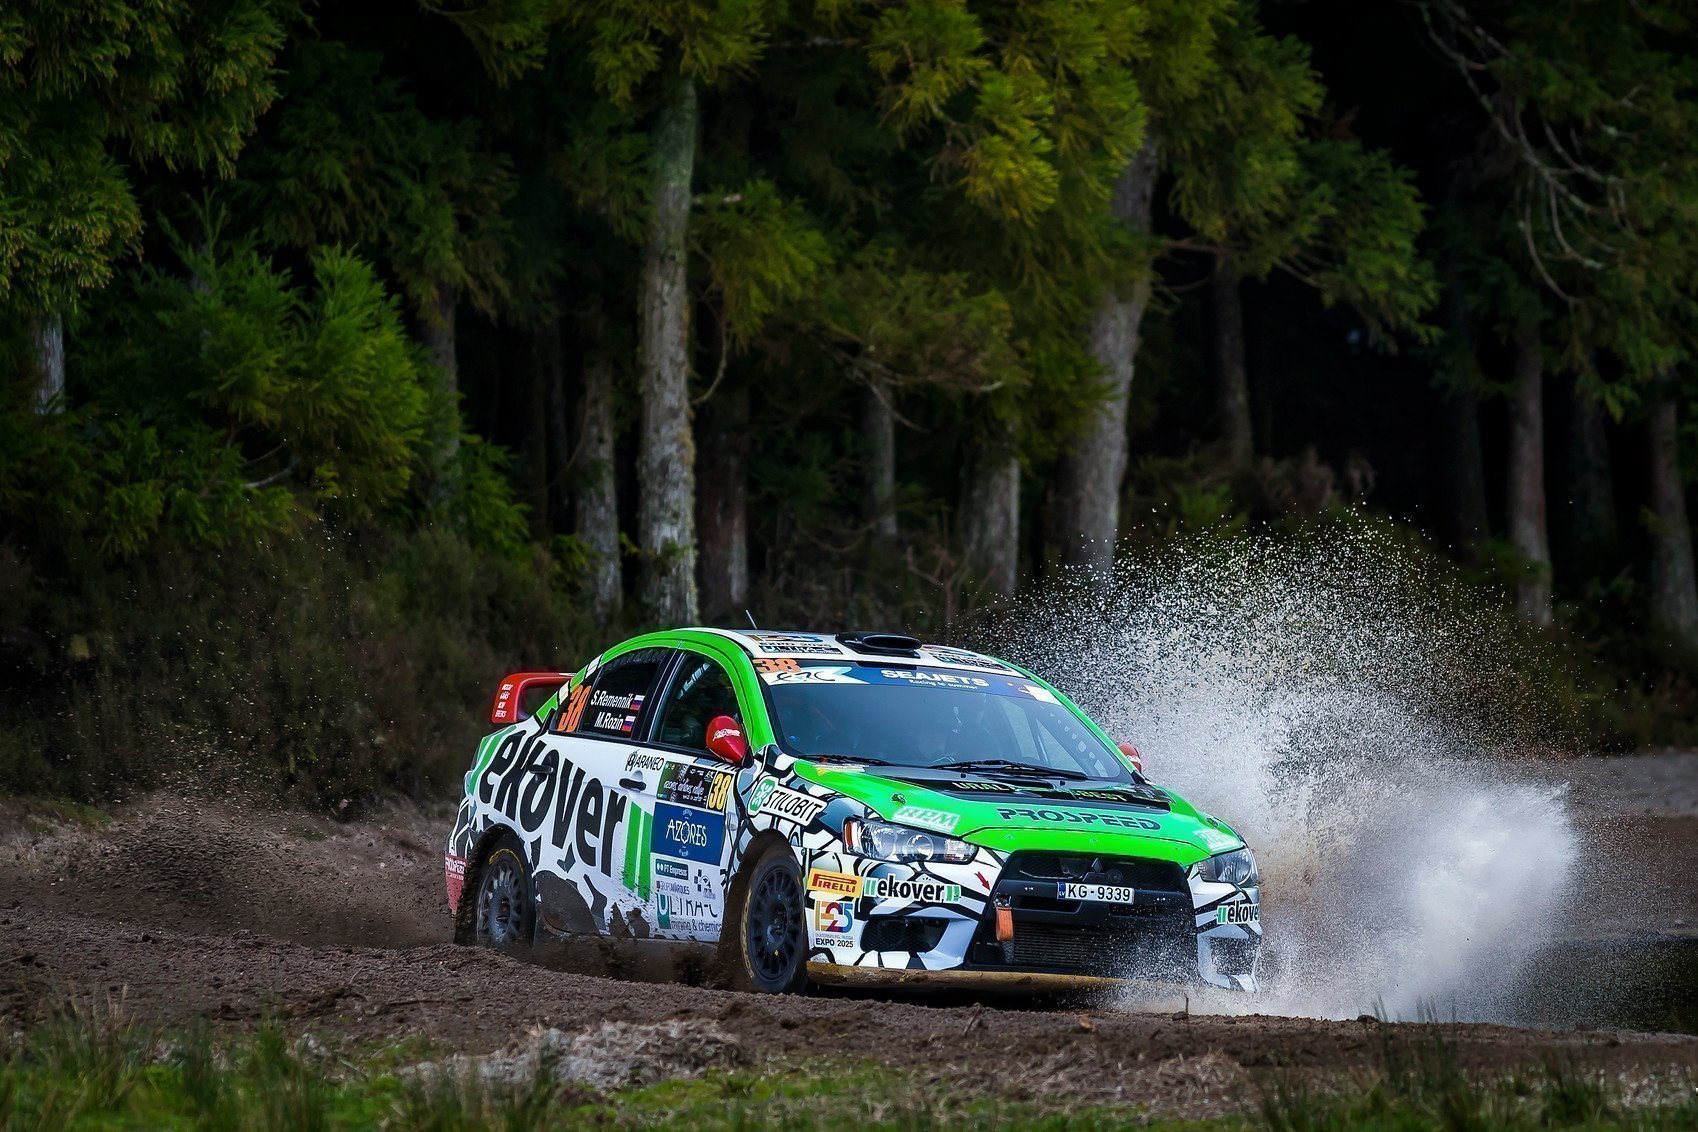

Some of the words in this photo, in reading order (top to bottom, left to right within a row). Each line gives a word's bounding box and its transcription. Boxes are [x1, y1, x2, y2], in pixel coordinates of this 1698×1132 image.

[752, 658, 801, 673] 38
[881, 669, 990, 687] SEAJETS
[557, 685, 592, 733] 38
[593, 711, 625, 731] M.Rozin
[634, 755, 665, 771] ARANEO
[708, 773, 733, 810] 38
[479, 730, 628, 878] ekover
[763, 789, 824, 821] STILOBIT
[996, 808, 1162, 831] PROSPEED
[665, 819, 708, 847] AZORES
[812, 873, 857, 893] PIRELLI
[877, 875, 945, 901] ekover
[816, 938, 835, 947] EXPO
[837, 940, 854, 949] 2025
